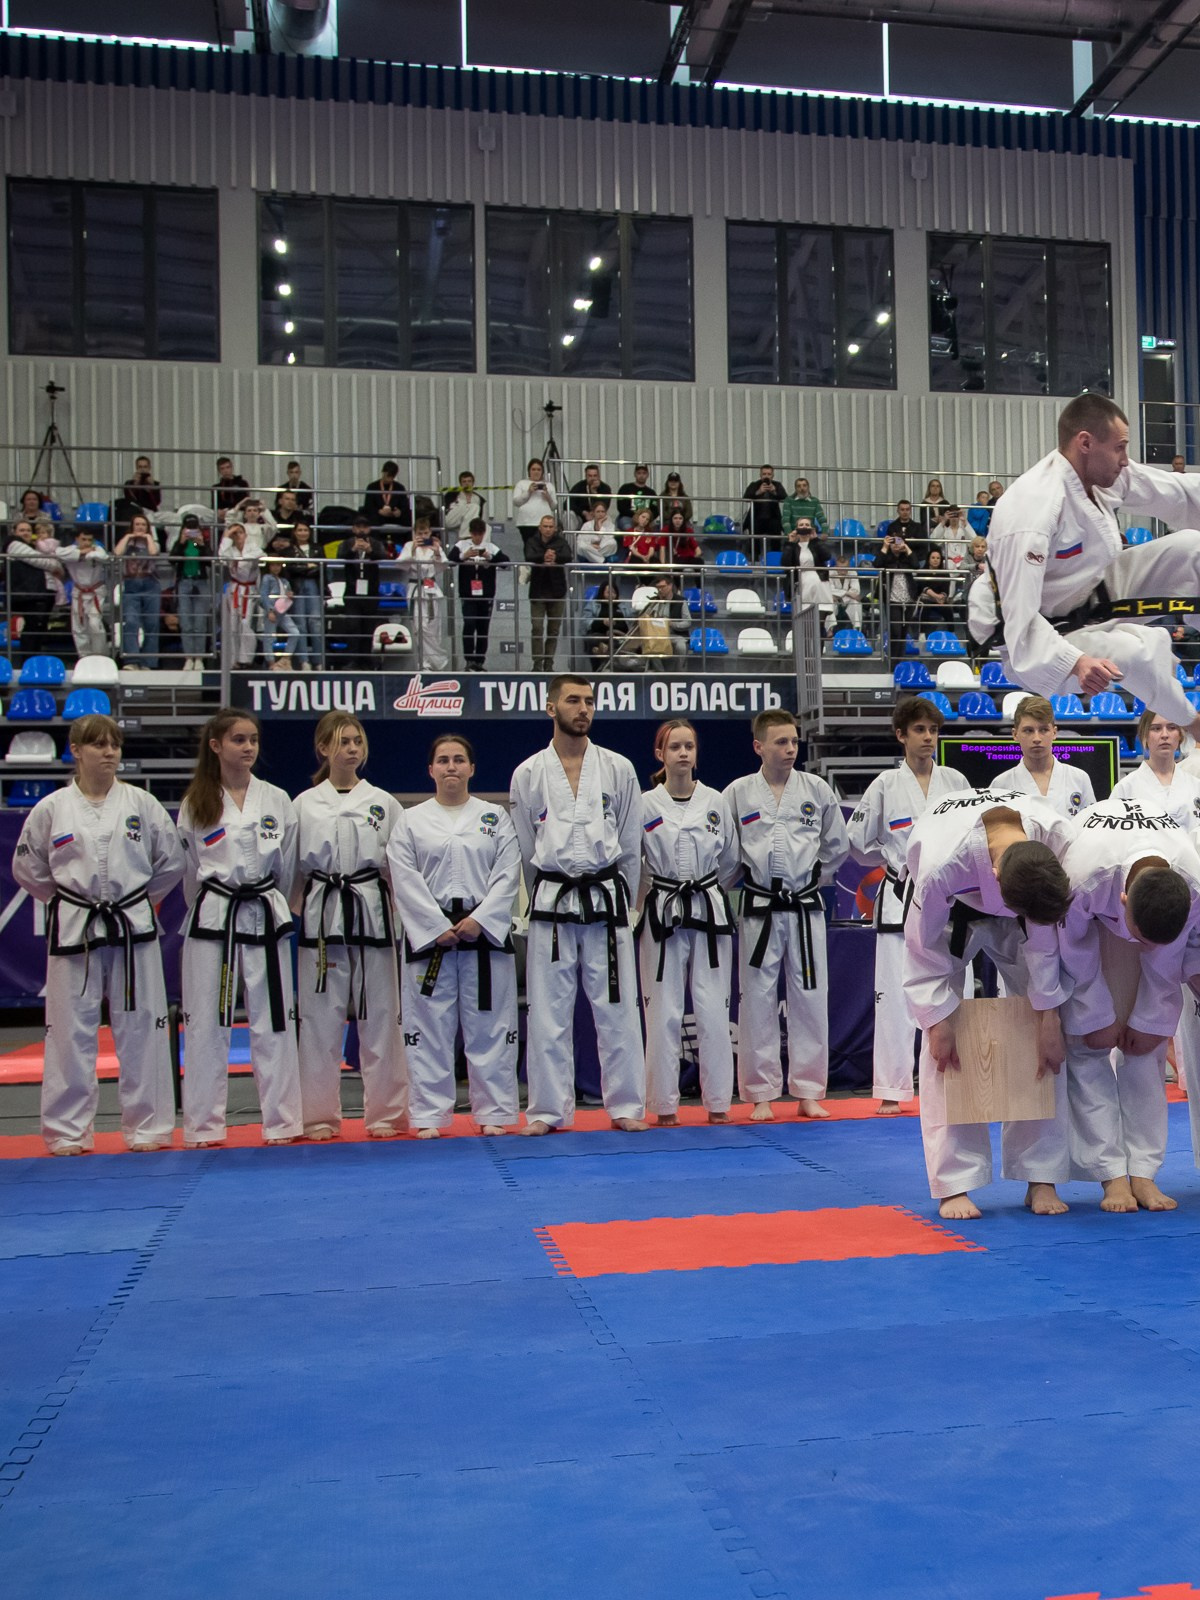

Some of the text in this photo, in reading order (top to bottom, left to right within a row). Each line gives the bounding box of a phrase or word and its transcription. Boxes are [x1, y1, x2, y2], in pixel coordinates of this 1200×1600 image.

[248, 680, 376, 713] ТУЛИЦА
[480, 681, 781, 712] ТУЛАЯ ОБЛАСТЬ
[961, 744, 1021, 753] Всероссийс
